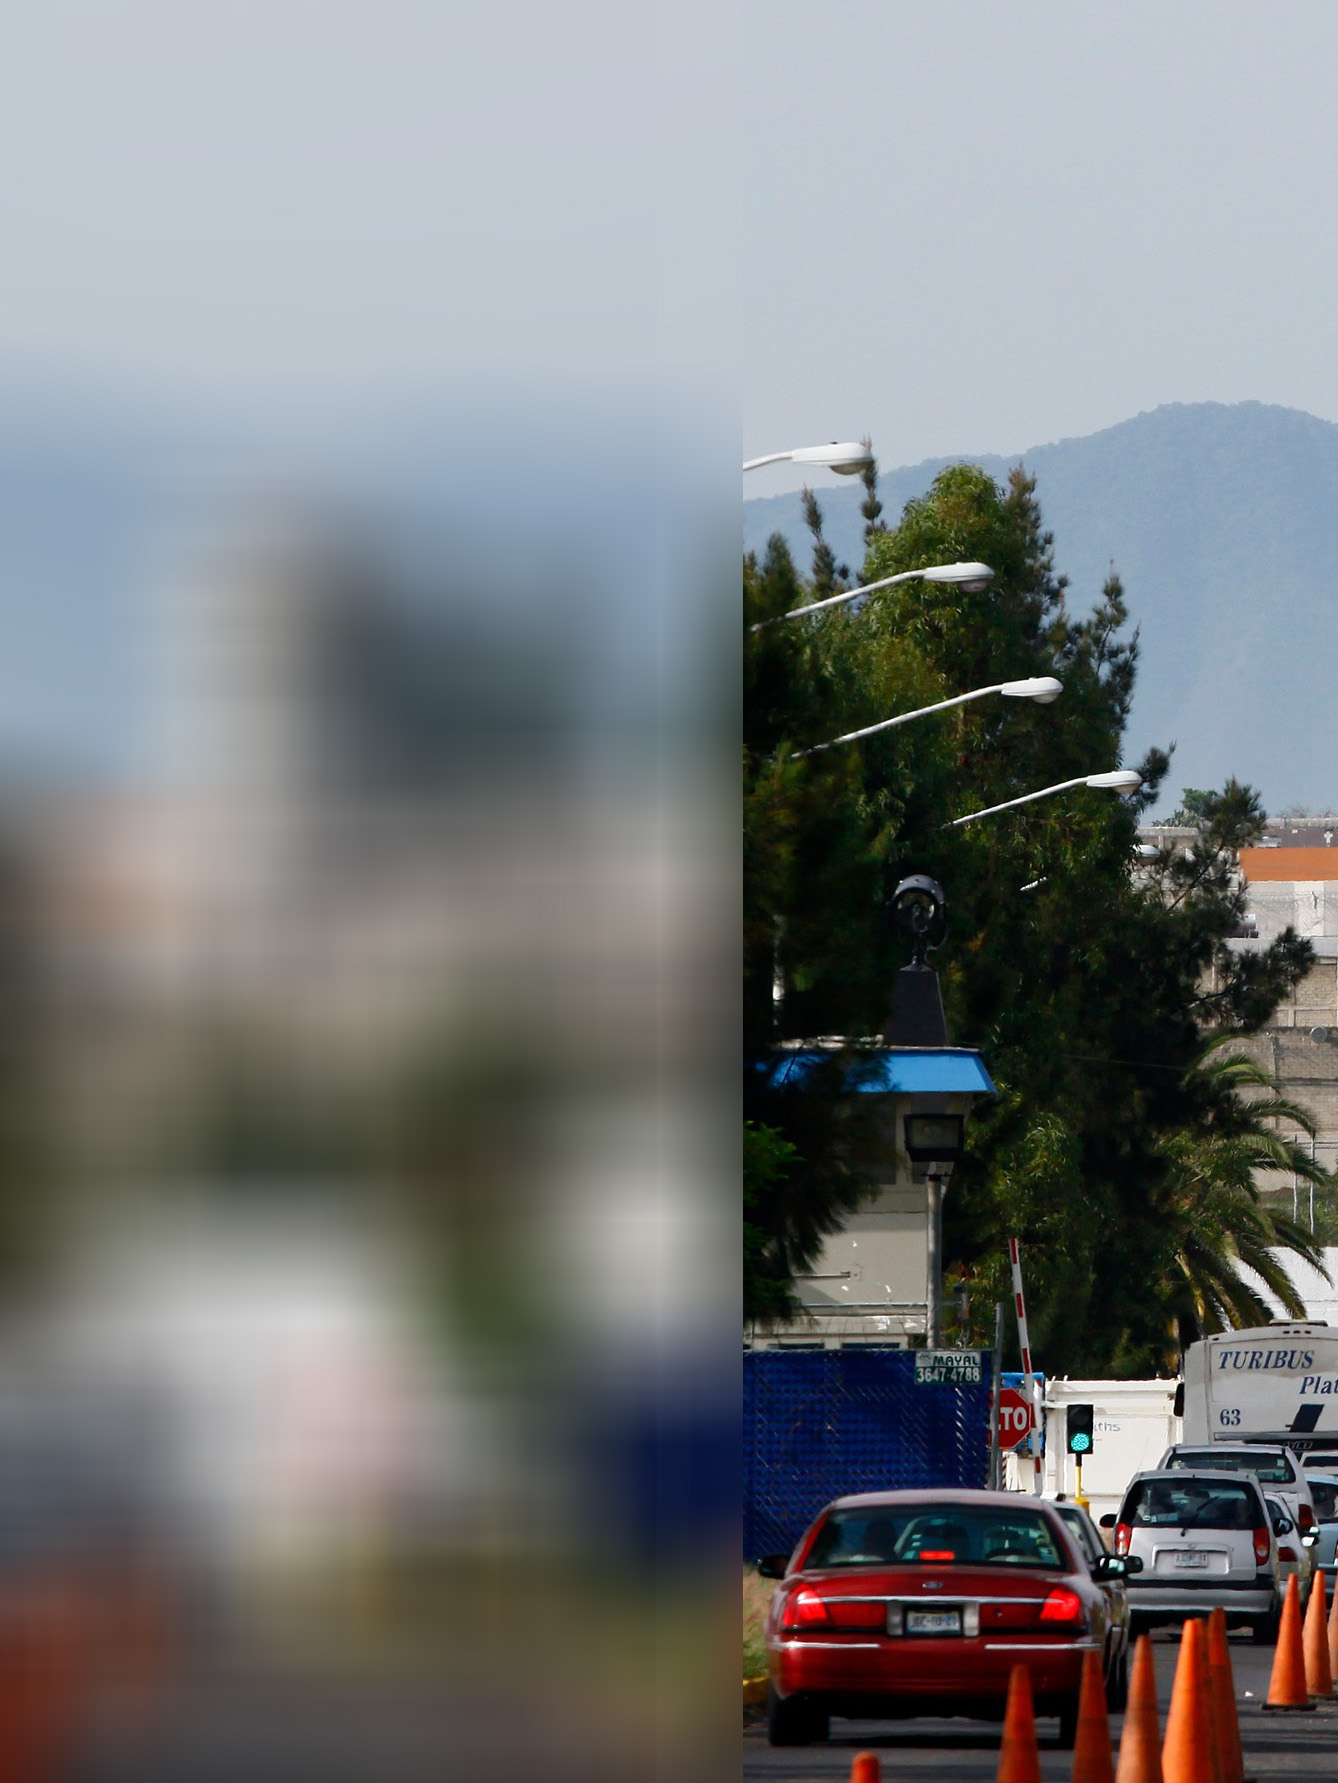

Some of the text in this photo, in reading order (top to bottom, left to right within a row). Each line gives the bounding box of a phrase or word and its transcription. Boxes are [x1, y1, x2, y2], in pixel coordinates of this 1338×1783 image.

[933, 1355, 979, 1366] MAYAL
[1218, 1350, 1315, 1370] TURIBUS
[1219, 1408, 1241, 1427] 63
